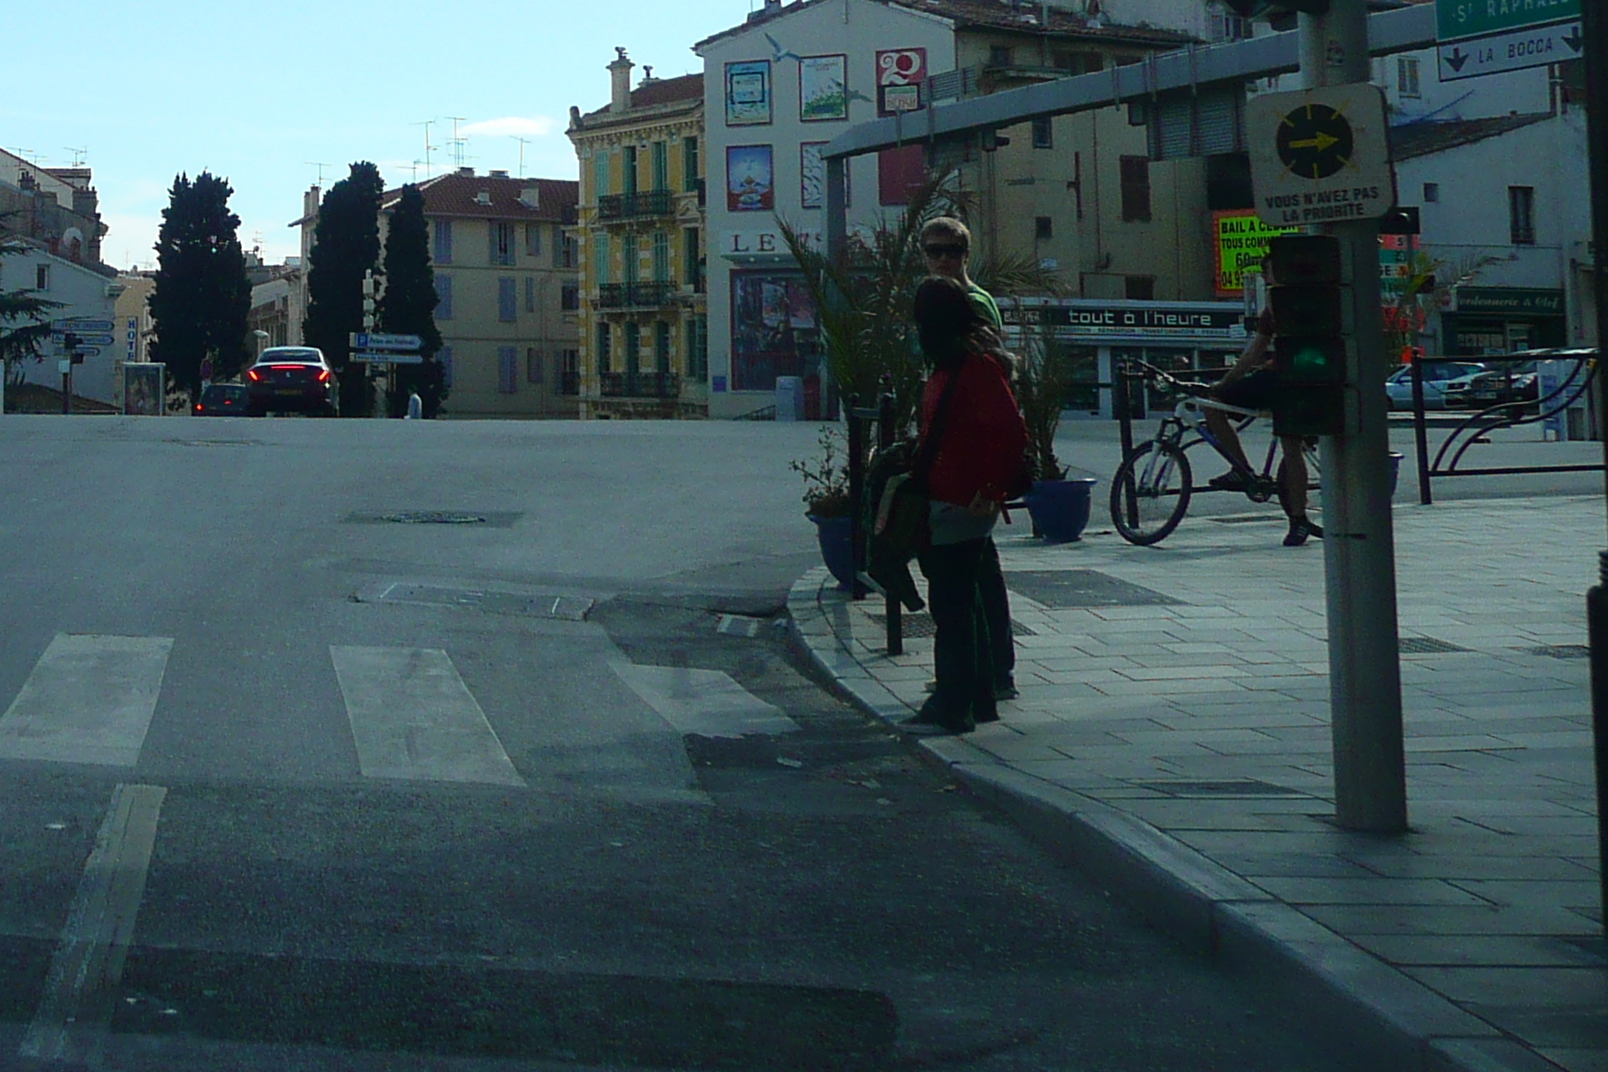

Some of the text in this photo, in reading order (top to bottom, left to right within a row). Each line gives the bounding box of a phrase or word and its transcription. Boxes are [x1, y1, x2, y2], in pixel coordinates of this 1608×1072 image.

[1478, 37, 1554, 64] LA BOCCA
[1265, 185, 1379, 209] VOUS N'AVEZ PAS
[1282, 202, 1364, 223] LA PRIORITE
[1221, 221, 1246, 234] BAIL
[1249, 220, 1256, 233] A
[732, 232, 775, 252] LE
[1221, 236, 1244, 249] TOUS
[1459, 295, 1519, 307] ordonnerie
[1069, 309, 1211, 326] tout à l'heure
[127, 319, 136, 360] HOTE
